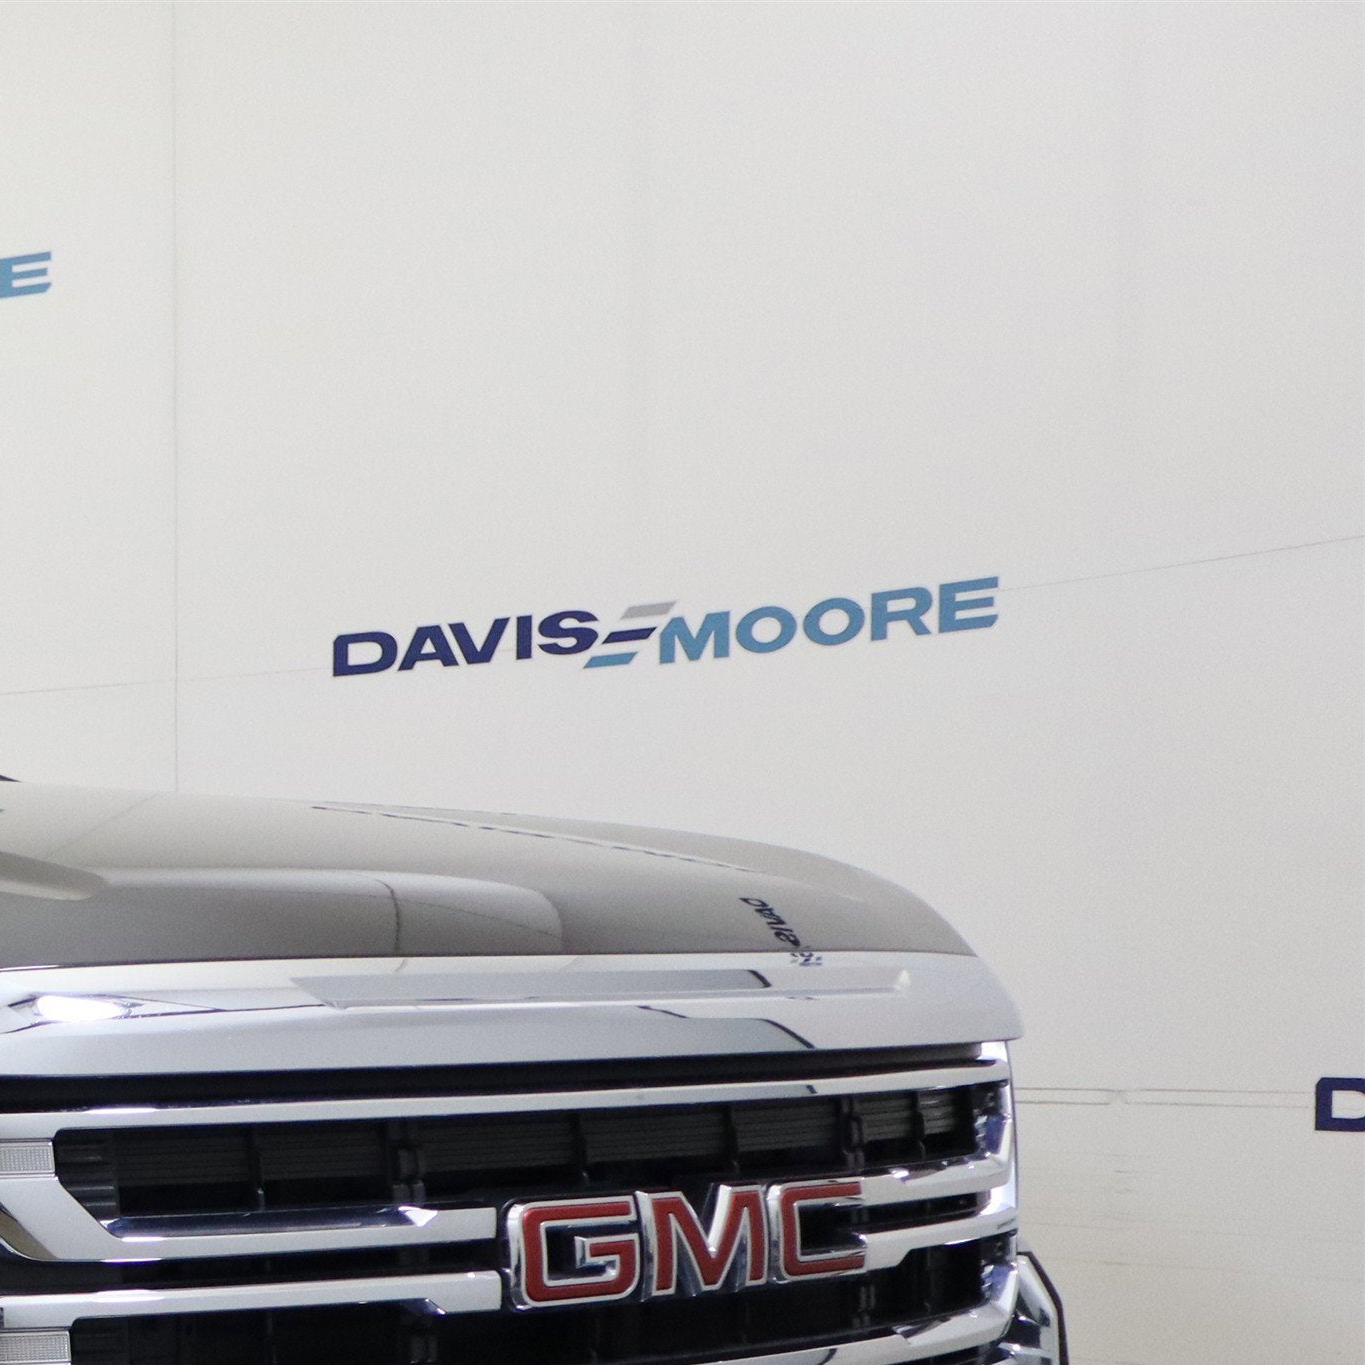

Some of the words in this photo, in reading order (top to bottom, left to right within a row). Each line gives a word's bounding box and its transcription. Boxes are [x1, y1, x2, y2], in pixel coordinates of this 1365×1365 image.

[332, 609, 600, 678] DAVIS
[658, 576, 1000, 665] MOORE
[507, 1179, 867, 1312] GMC
